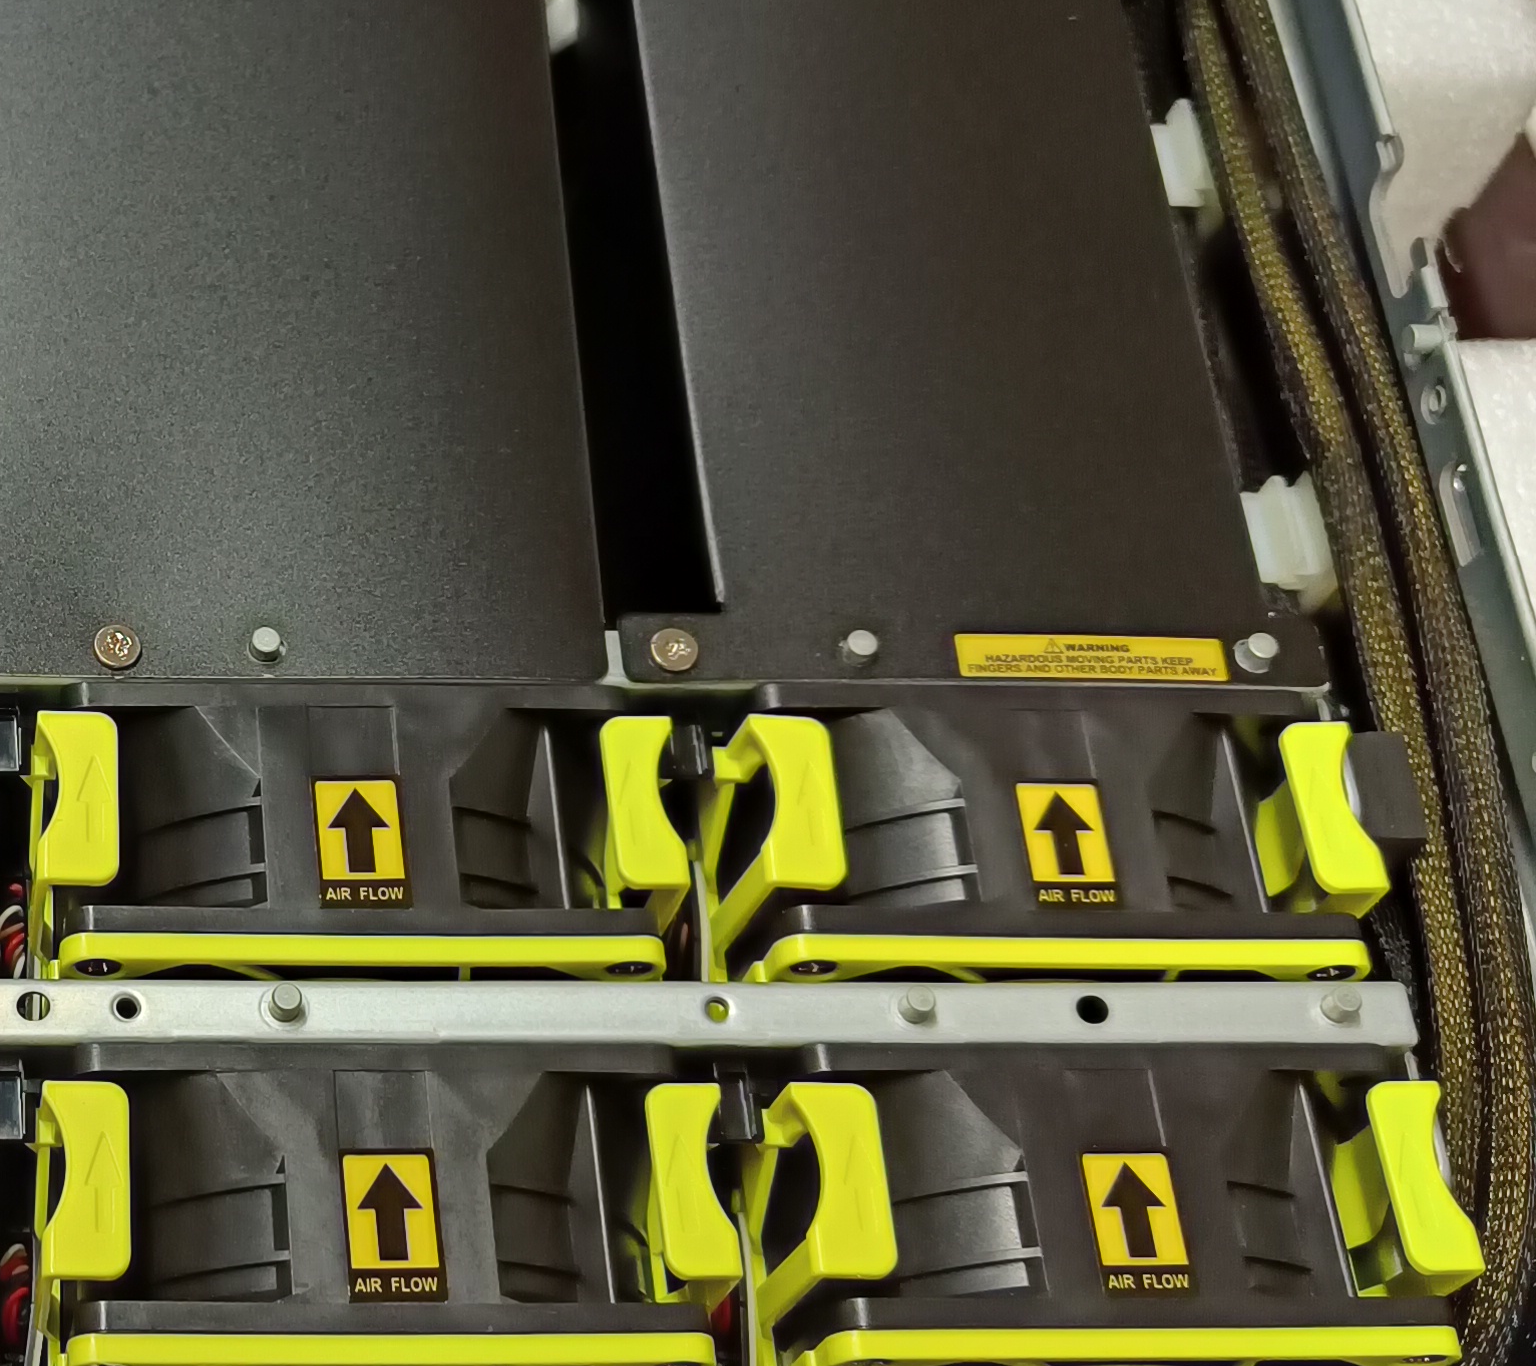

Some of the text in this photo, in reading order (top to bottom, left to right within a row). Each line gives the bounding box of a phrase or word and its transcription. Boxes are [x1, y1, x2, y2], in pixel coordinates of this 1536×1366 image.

[1064, 643, 1130, 653] WARNING
[985, 654, 1193, 666] HAZARDOUS MOVING PARTS KEEP
[967, 663, 1217, 676] FINGERS AND OTHER BODY PARTS AWAY
[325, 886, 404, 901] AIR FLOW
[1038, 889, 1116, 903] AIR FLOW
[354, 1276, 438, 1293] AIR FLOW
[1108, 1273, 1190, 1289] AIR FLOW
